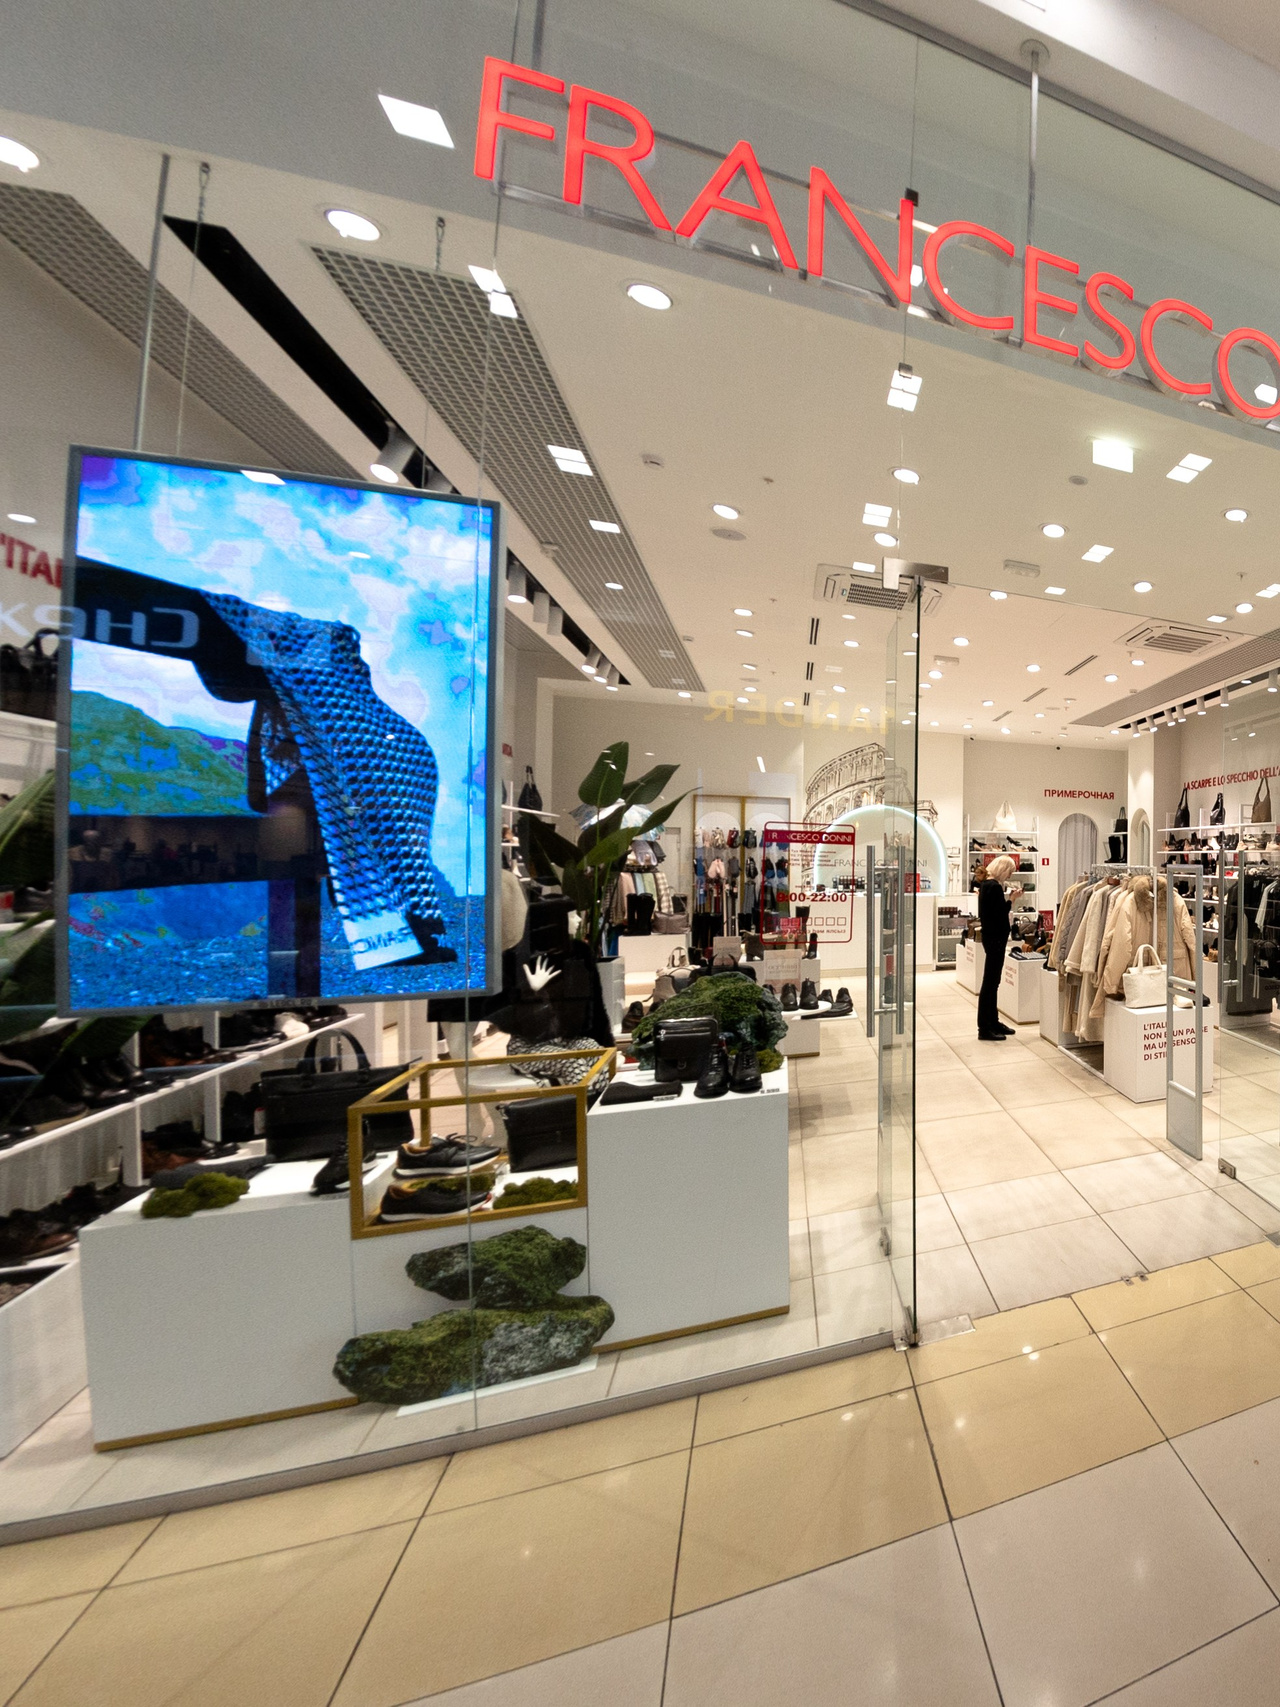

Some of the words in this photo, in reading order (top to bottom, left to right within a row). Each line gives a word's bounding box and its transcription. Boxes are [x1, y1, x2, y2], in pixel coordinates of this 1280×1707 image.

[1191, 778, 1212, 791] SCARPE
[1226, 770, 1259, 785] SPECCHIO
[1044, 788, 1115, 801] ПРИМЕРОЧНАЯ
[767, 832, 820, 842] FRNCESCO
[776, 892, 848, 904] 9:00-22:00
[1143, 1021, 1168, 1031] L'ITALI
[1143, 1032, 1162, 1041] NON
[1172, 1029, 1184, 1037] UN
[1186, 1025, 1209, 1035] PAE
[1143, 1043, 1157, 1051] MA
[1172, 1037, 1196, 1048] SENSO
[1143, 1053, 1152, 1061] DI
